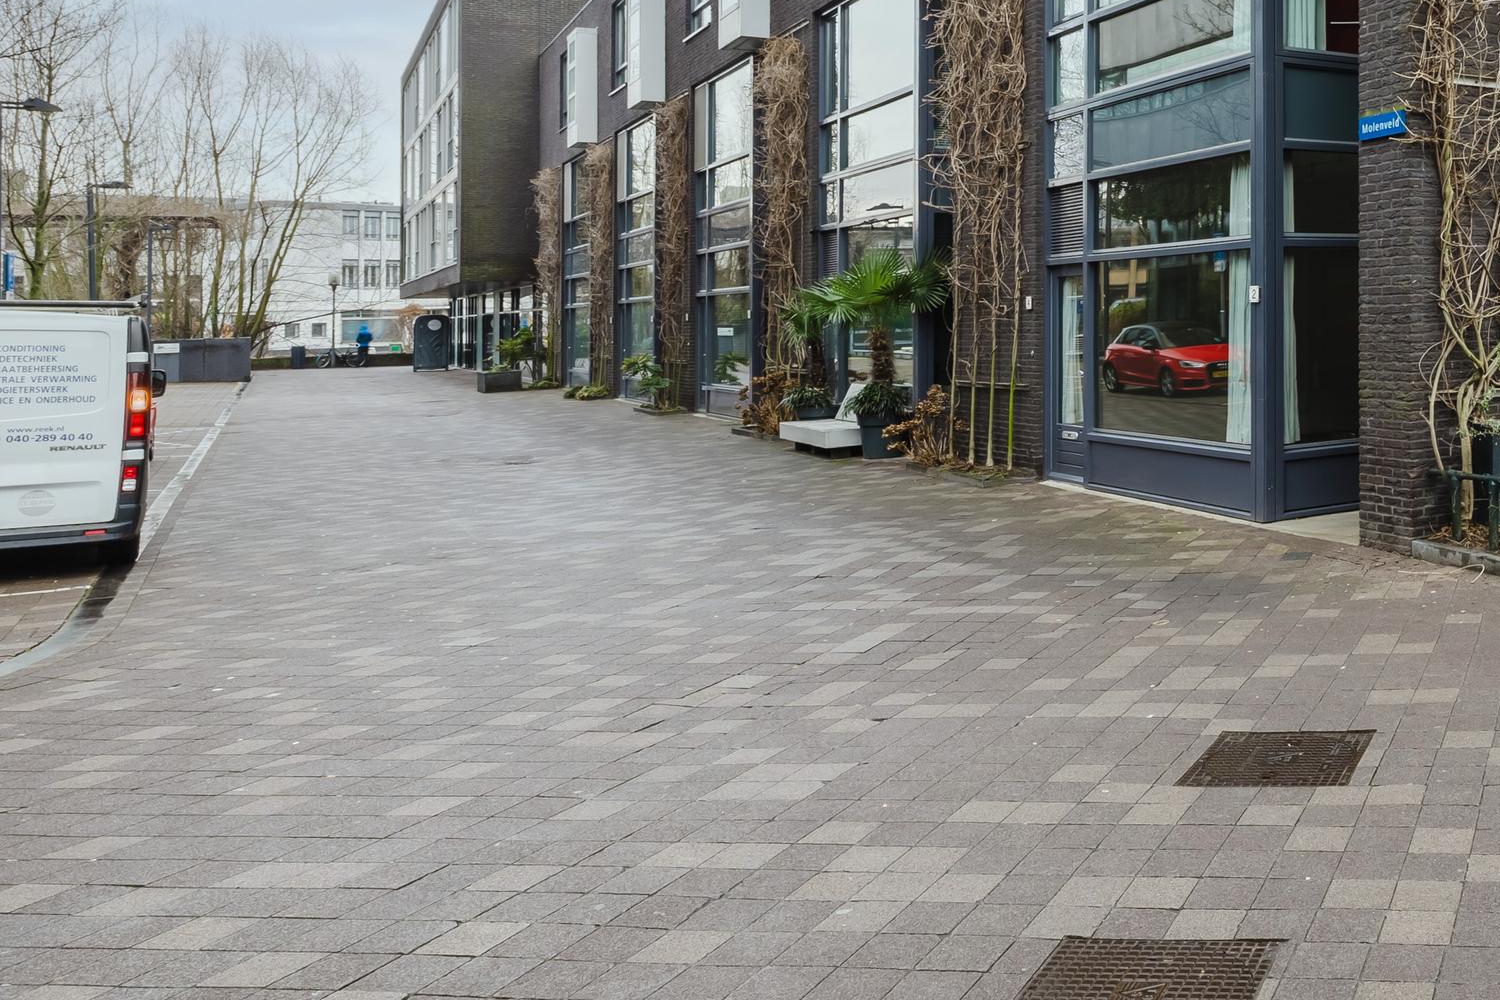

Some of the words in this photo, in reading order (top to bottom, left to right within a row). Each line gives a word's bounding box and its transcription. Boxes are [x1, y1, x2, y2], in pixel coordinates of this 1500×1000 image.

[1361, 116, 1400, 134] Molenveld
[0, 344, 66, 353] ONDITIONING
[0, 376, 26, 384] RALE
[31, 374, 98, 383] VERWARMING
[19, 397, 32, 405] EN
[36, 395, 97, 404] ONDERHOUD
[7, 425, 65, 433] www.reek.nl
[6, 434, 57, 443] 040-289
[60, 433, 75, 441] 40
[78, 432, 94, 441] 40
[49, 443, 107, 452] RENAULT
